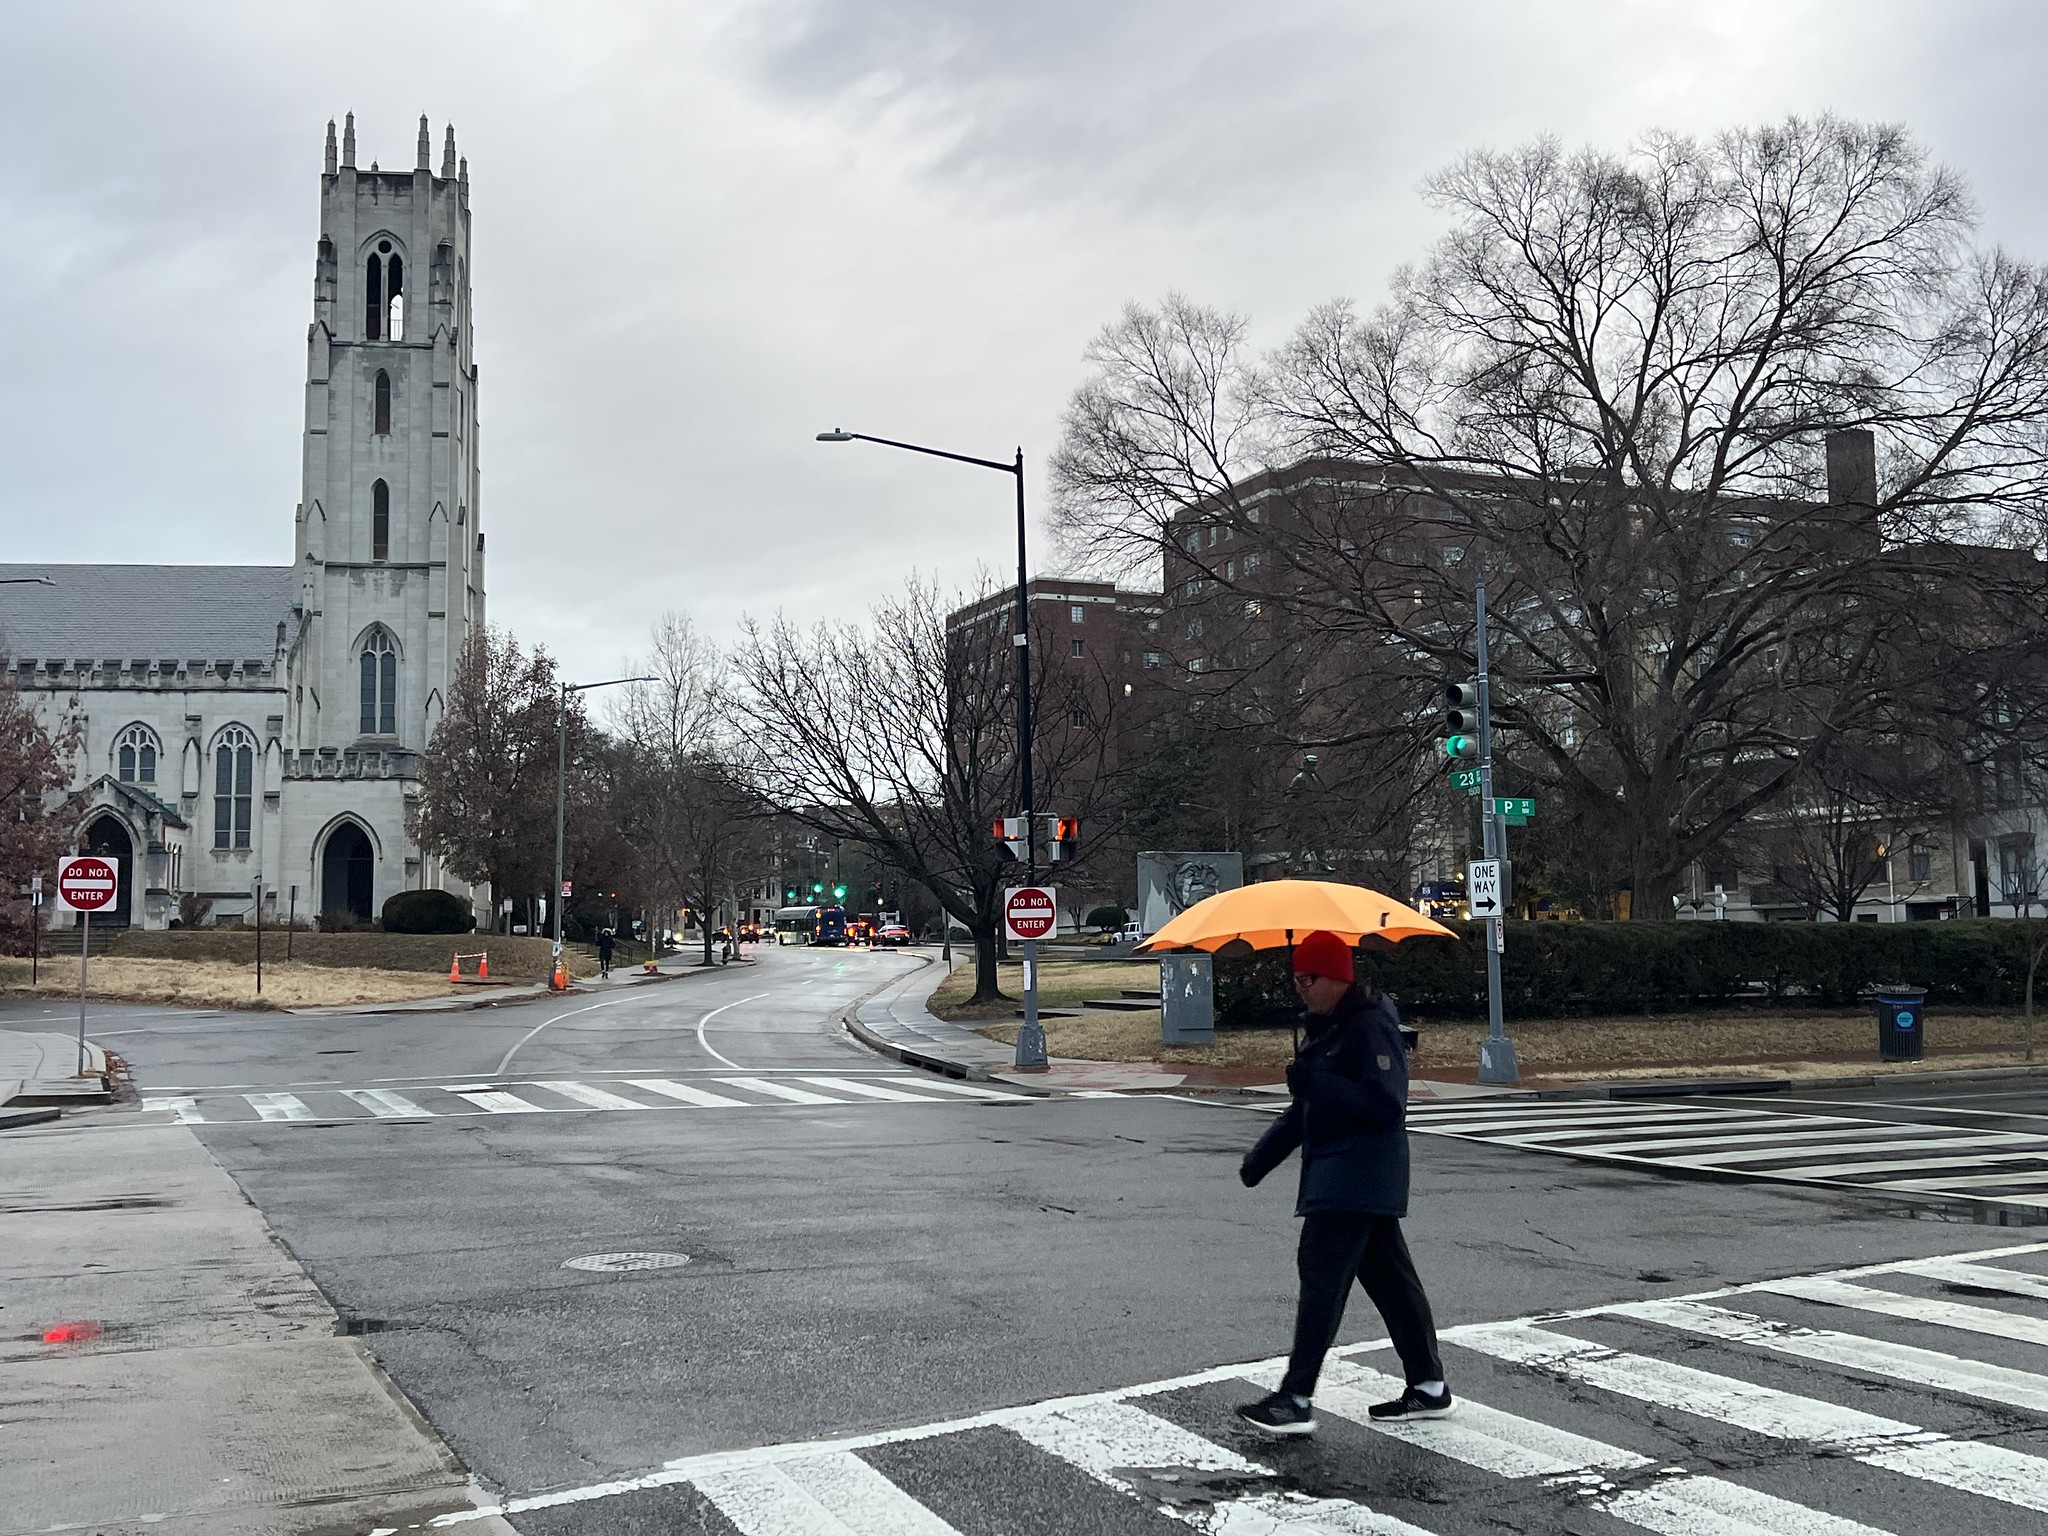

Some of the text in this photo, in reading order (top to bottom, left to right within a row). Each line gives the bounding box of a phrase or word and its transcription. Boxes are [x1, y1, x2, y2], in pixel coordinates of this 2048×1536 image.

[1459, 772, 1474, 786] 23
[1504, 800, 1530, 814] P ST
[68, 867, 109, 877] DO NOT
[1474, 865, 1495, 878] ONE
[1474, 880, 1496, 893] WAY
[71, 891, 104, 900] ENTER
[1013, 897, 1048, 907] DO NOT
[1016, 920, 1046, 929] ENTER
